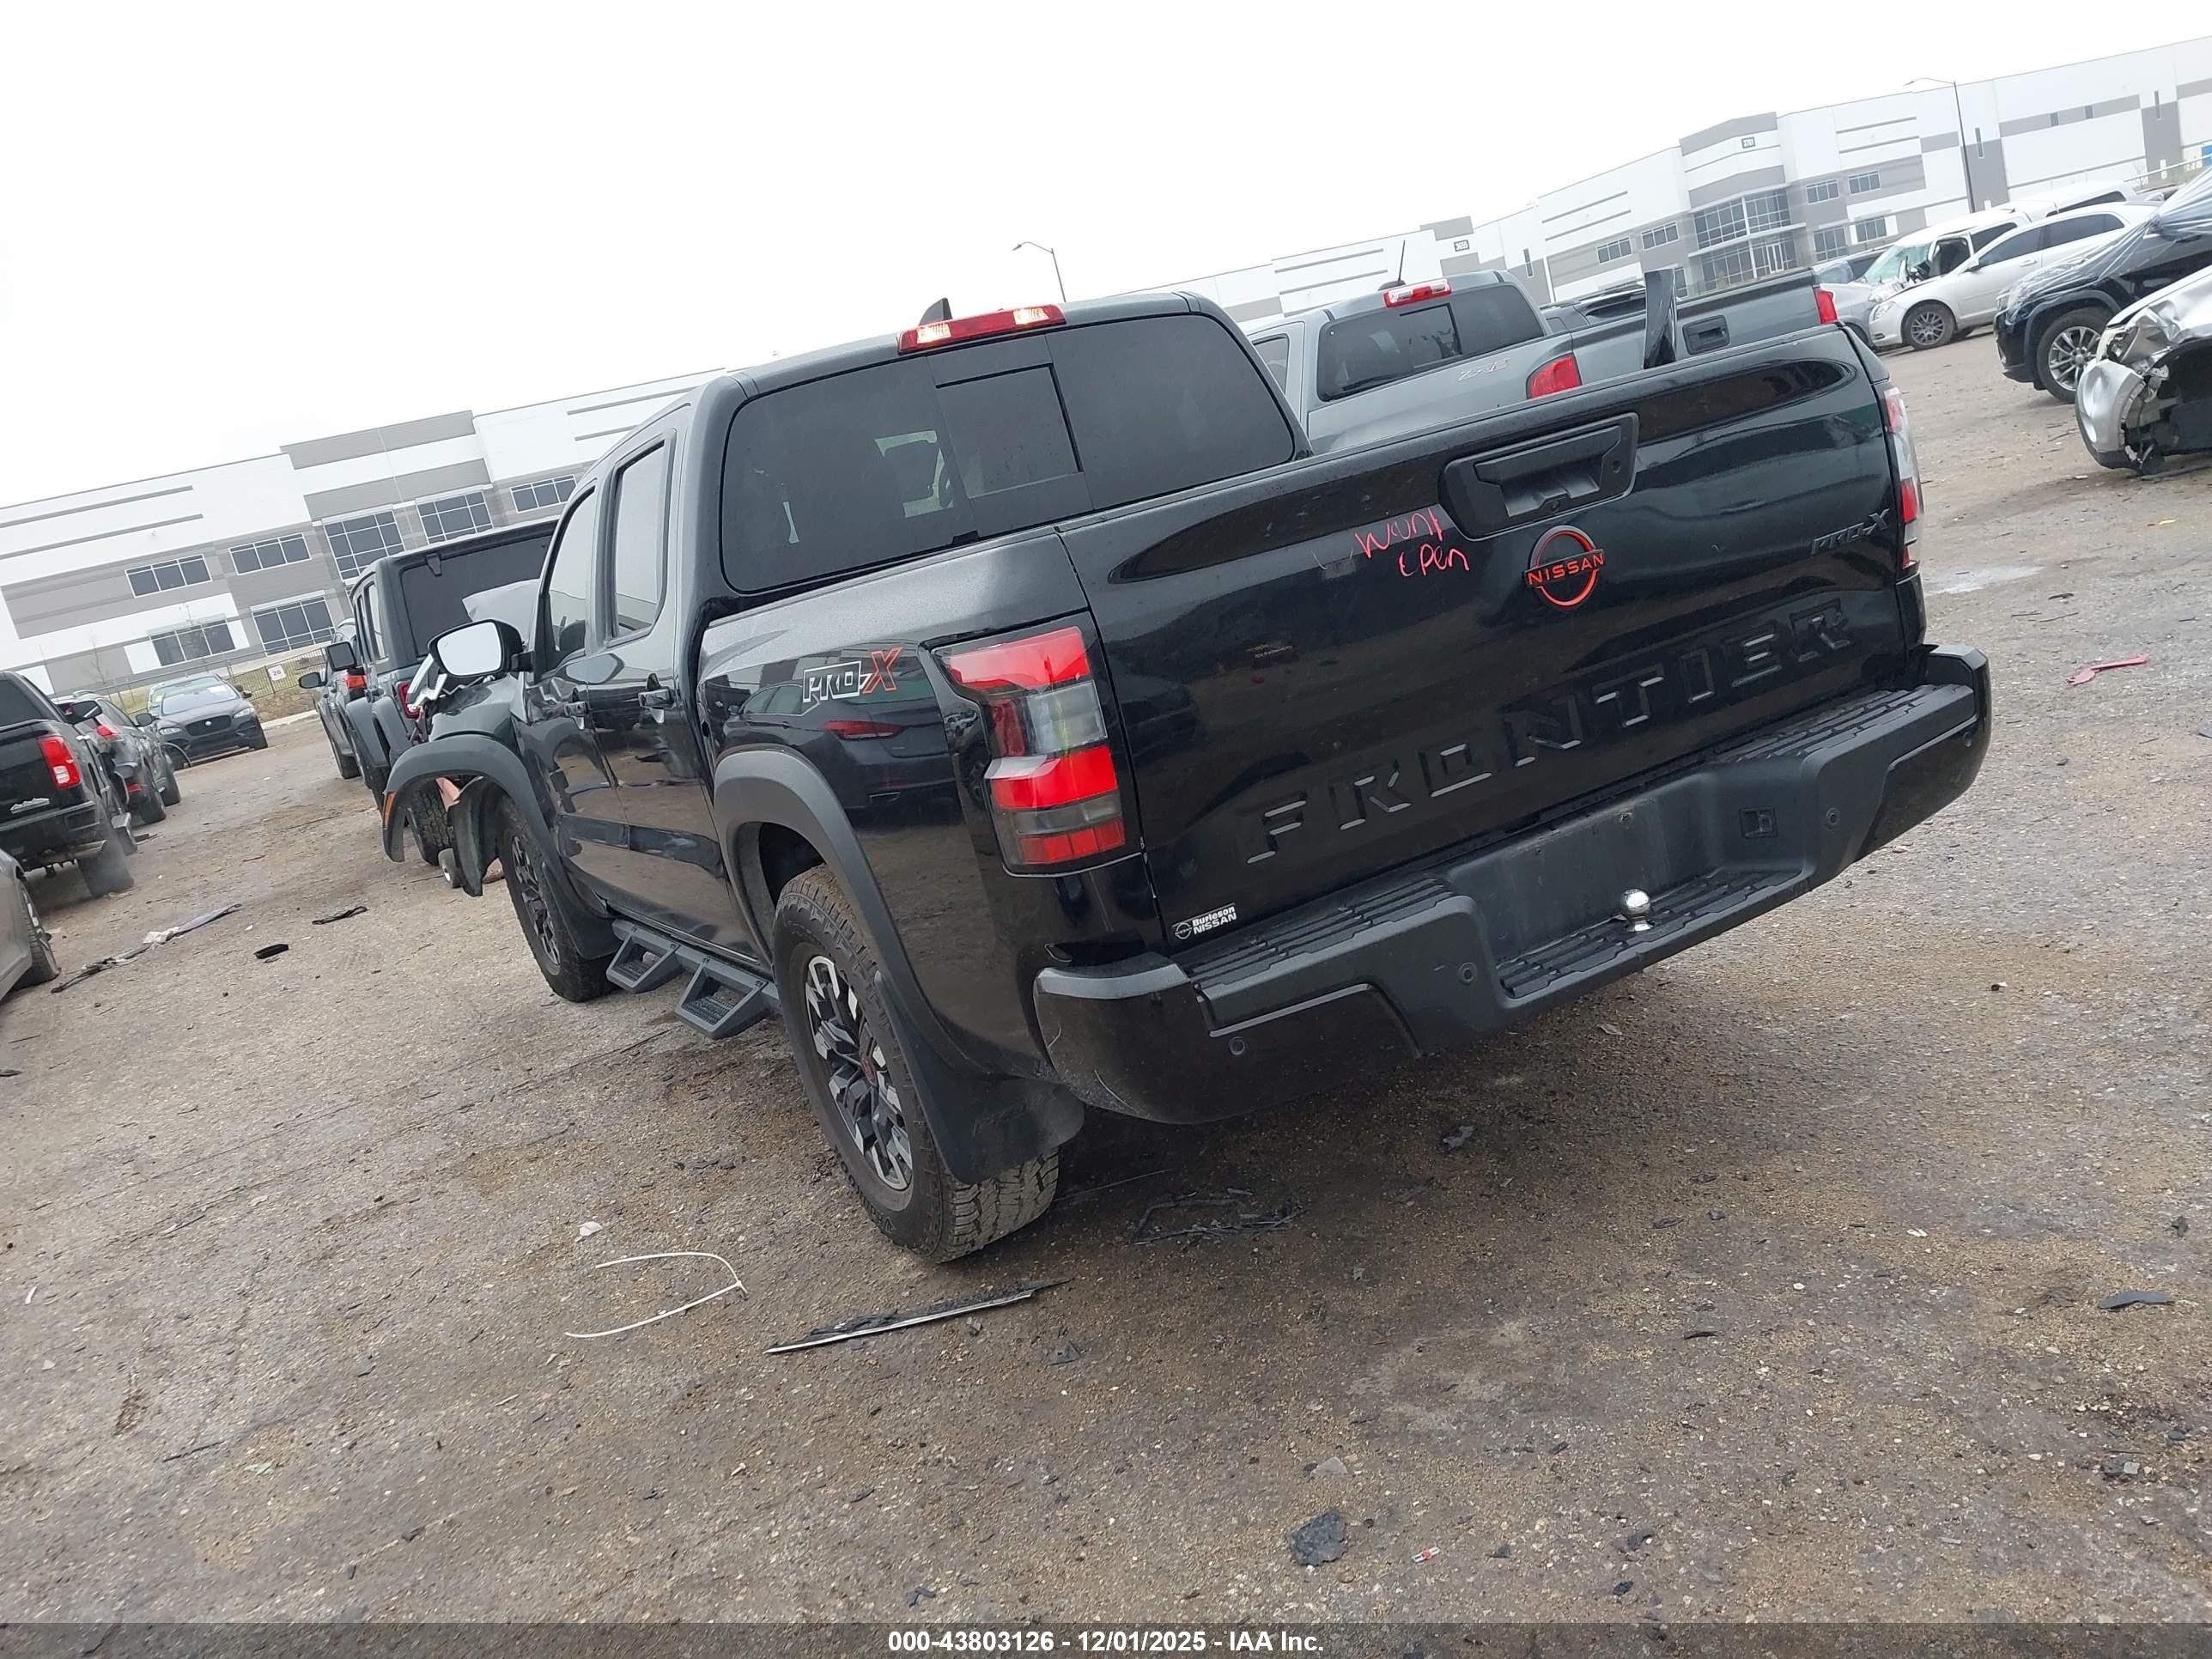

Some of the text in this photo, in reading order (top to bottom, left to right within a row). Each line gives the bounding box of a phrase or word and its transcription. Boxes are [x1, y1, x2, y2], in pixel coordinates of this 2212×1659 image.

[1528, 553, 1604, 585] NISSAN
[1237, 597, 1853, 864] FRONTIER
[1192, 906, 1235, 927] Burleson
[1193, 912, 1237, 935] NISSAN
